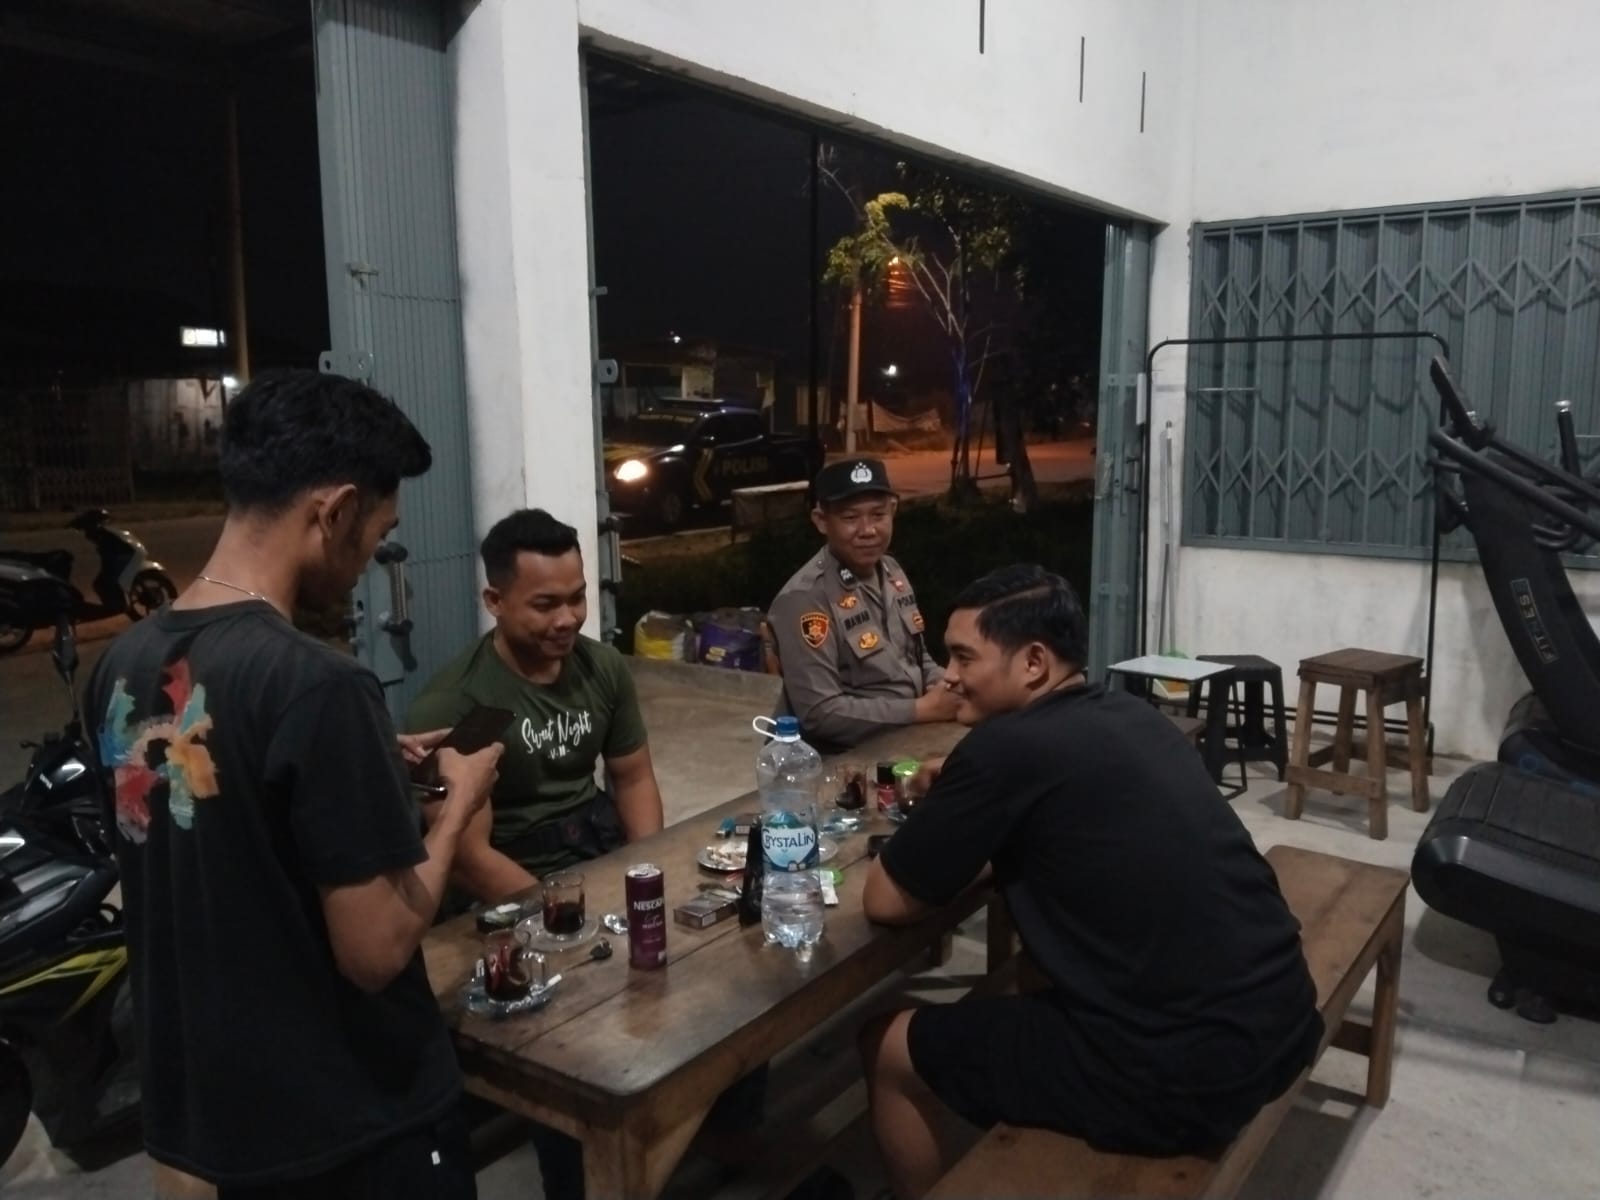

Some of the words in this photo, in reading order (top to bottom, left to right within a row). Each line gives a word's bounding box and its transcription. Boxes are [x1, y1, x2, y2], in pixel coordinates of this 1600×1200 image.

[1514, 583, 1553, 660] FITES
[521, 717, 554, 754] Sweet
[557, 710, 592, 746] Night
